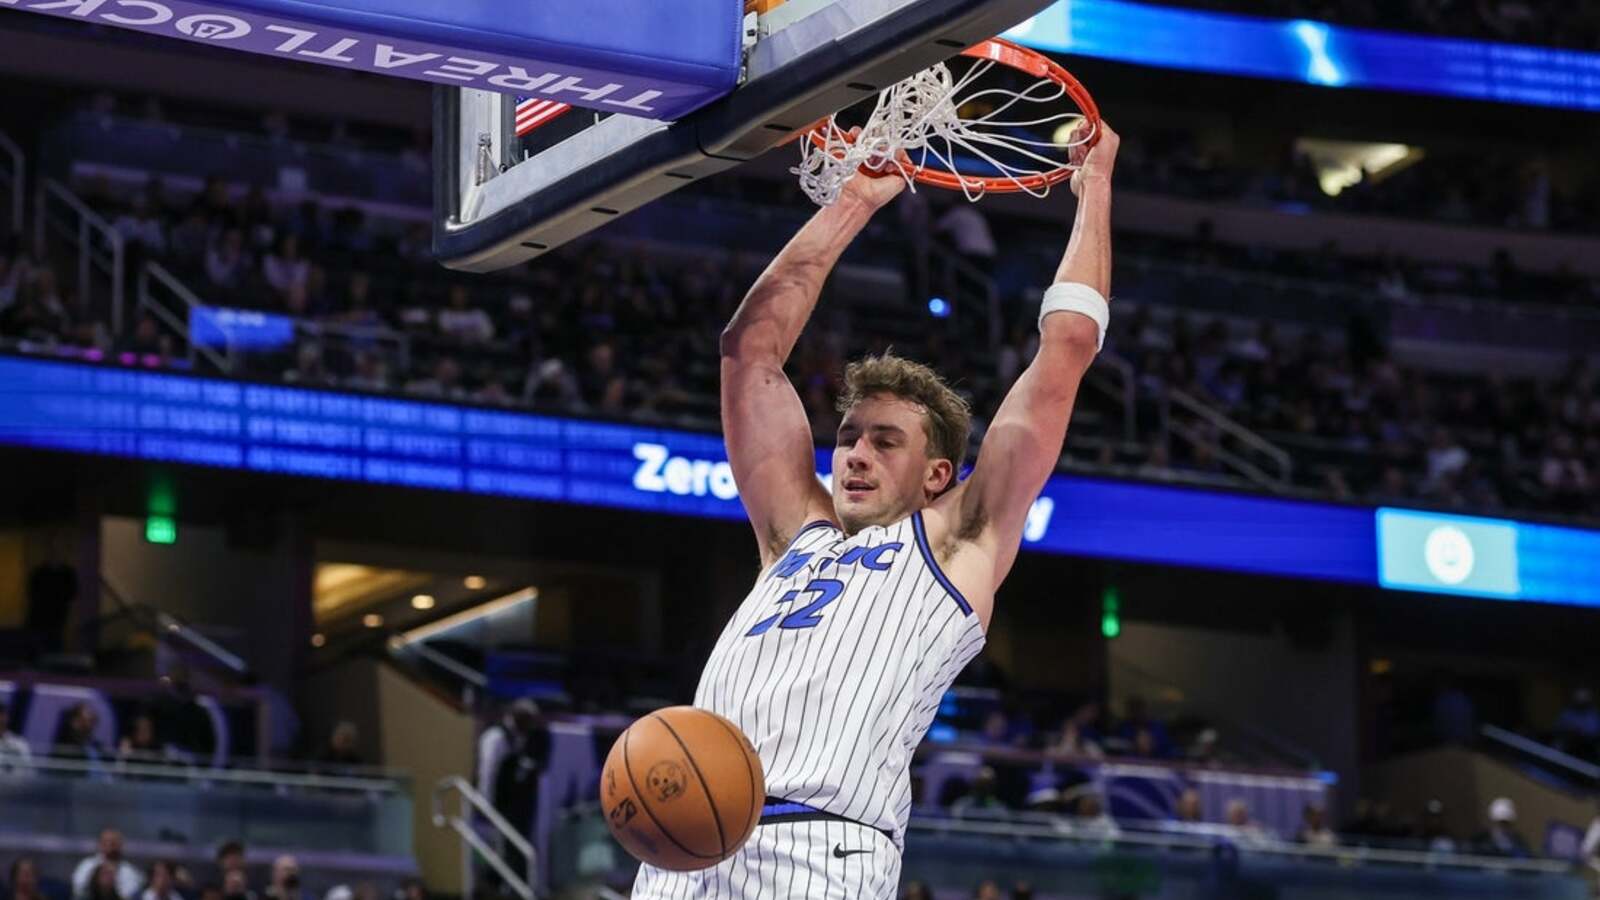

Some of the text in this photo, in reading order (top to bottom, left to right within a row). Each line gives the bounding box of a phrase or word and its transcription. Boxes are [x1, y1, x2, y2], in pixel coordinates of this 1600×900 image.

[0, 0, 663, 112] THREATLOCK
[633, 442, 739, 500] Zero
[765, 542, 905, 583] MIC
